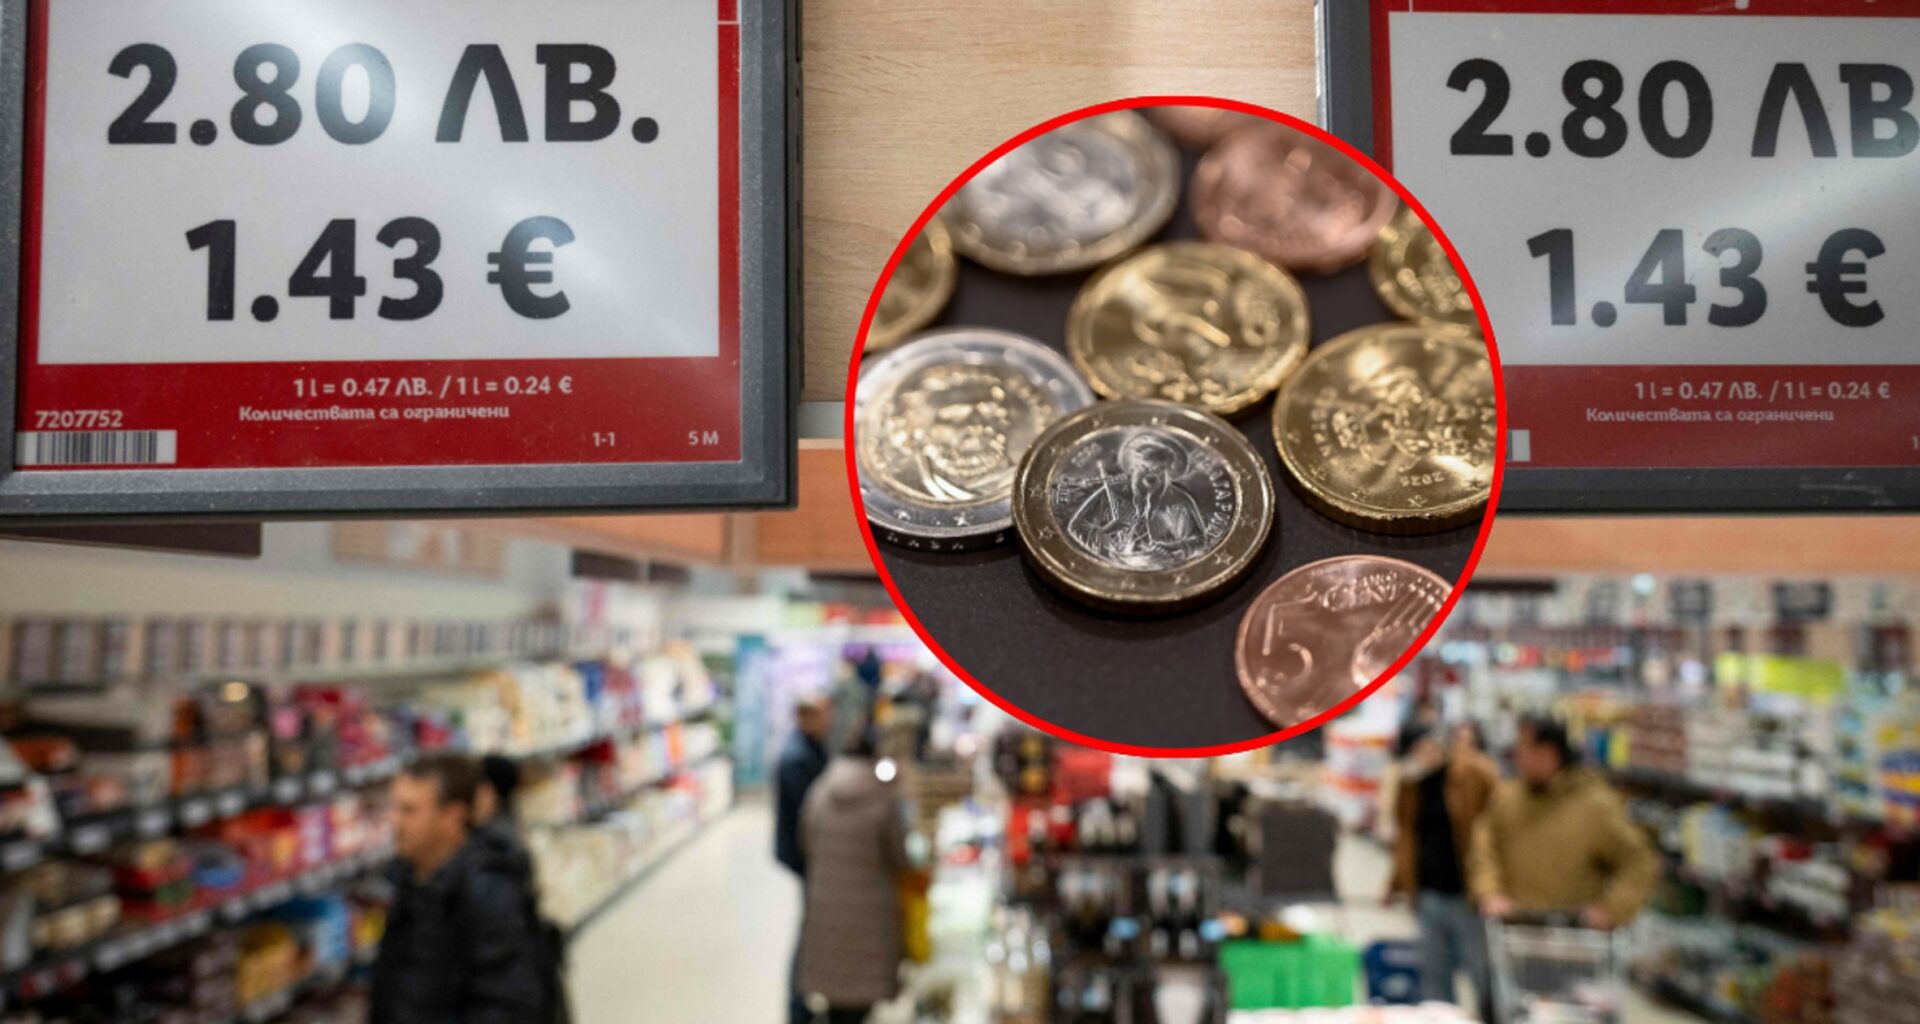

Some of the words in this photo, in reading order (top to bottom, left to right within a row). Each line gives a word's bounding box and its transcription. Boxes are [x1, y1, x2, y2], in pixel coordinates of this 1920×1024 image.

[106, 43, 396, 146] 2.80
[435, 43, 660, 143] ЛВ.
[1446, 58, 1713, 159] 2.80
[184, 216, 444, 322] 1.43
[486, 215, 576, 320] €
[1526, 228, 1768, 329] 1.43
[1805, 228, 1887, 329] €
[341, 378, 391, 397] 0.47
[503, 375, 552, 395] 0.24
[558, 375, 573, 395] €
[1678, 382, 1724, 400] 0.47
[1827, 382, 1872, 400] 0.24
[1877, 382, 1892, 400] €
[35, 409, 123, 429] 7207752
[239, 404, 376, 422] Количествата
[379, 408, 400, 421] са
[403, 406, 510, 423] ограничени
[1585, 407, 1711, 422] Количествата
[1715, 409, 1733, 422] са
[1736, 410, 1835, 426] ограничени
[592, 431, 616, 447] 1-1
[688, 430, 700, 446] 5
[1262, 592, 1318, 688] 5
